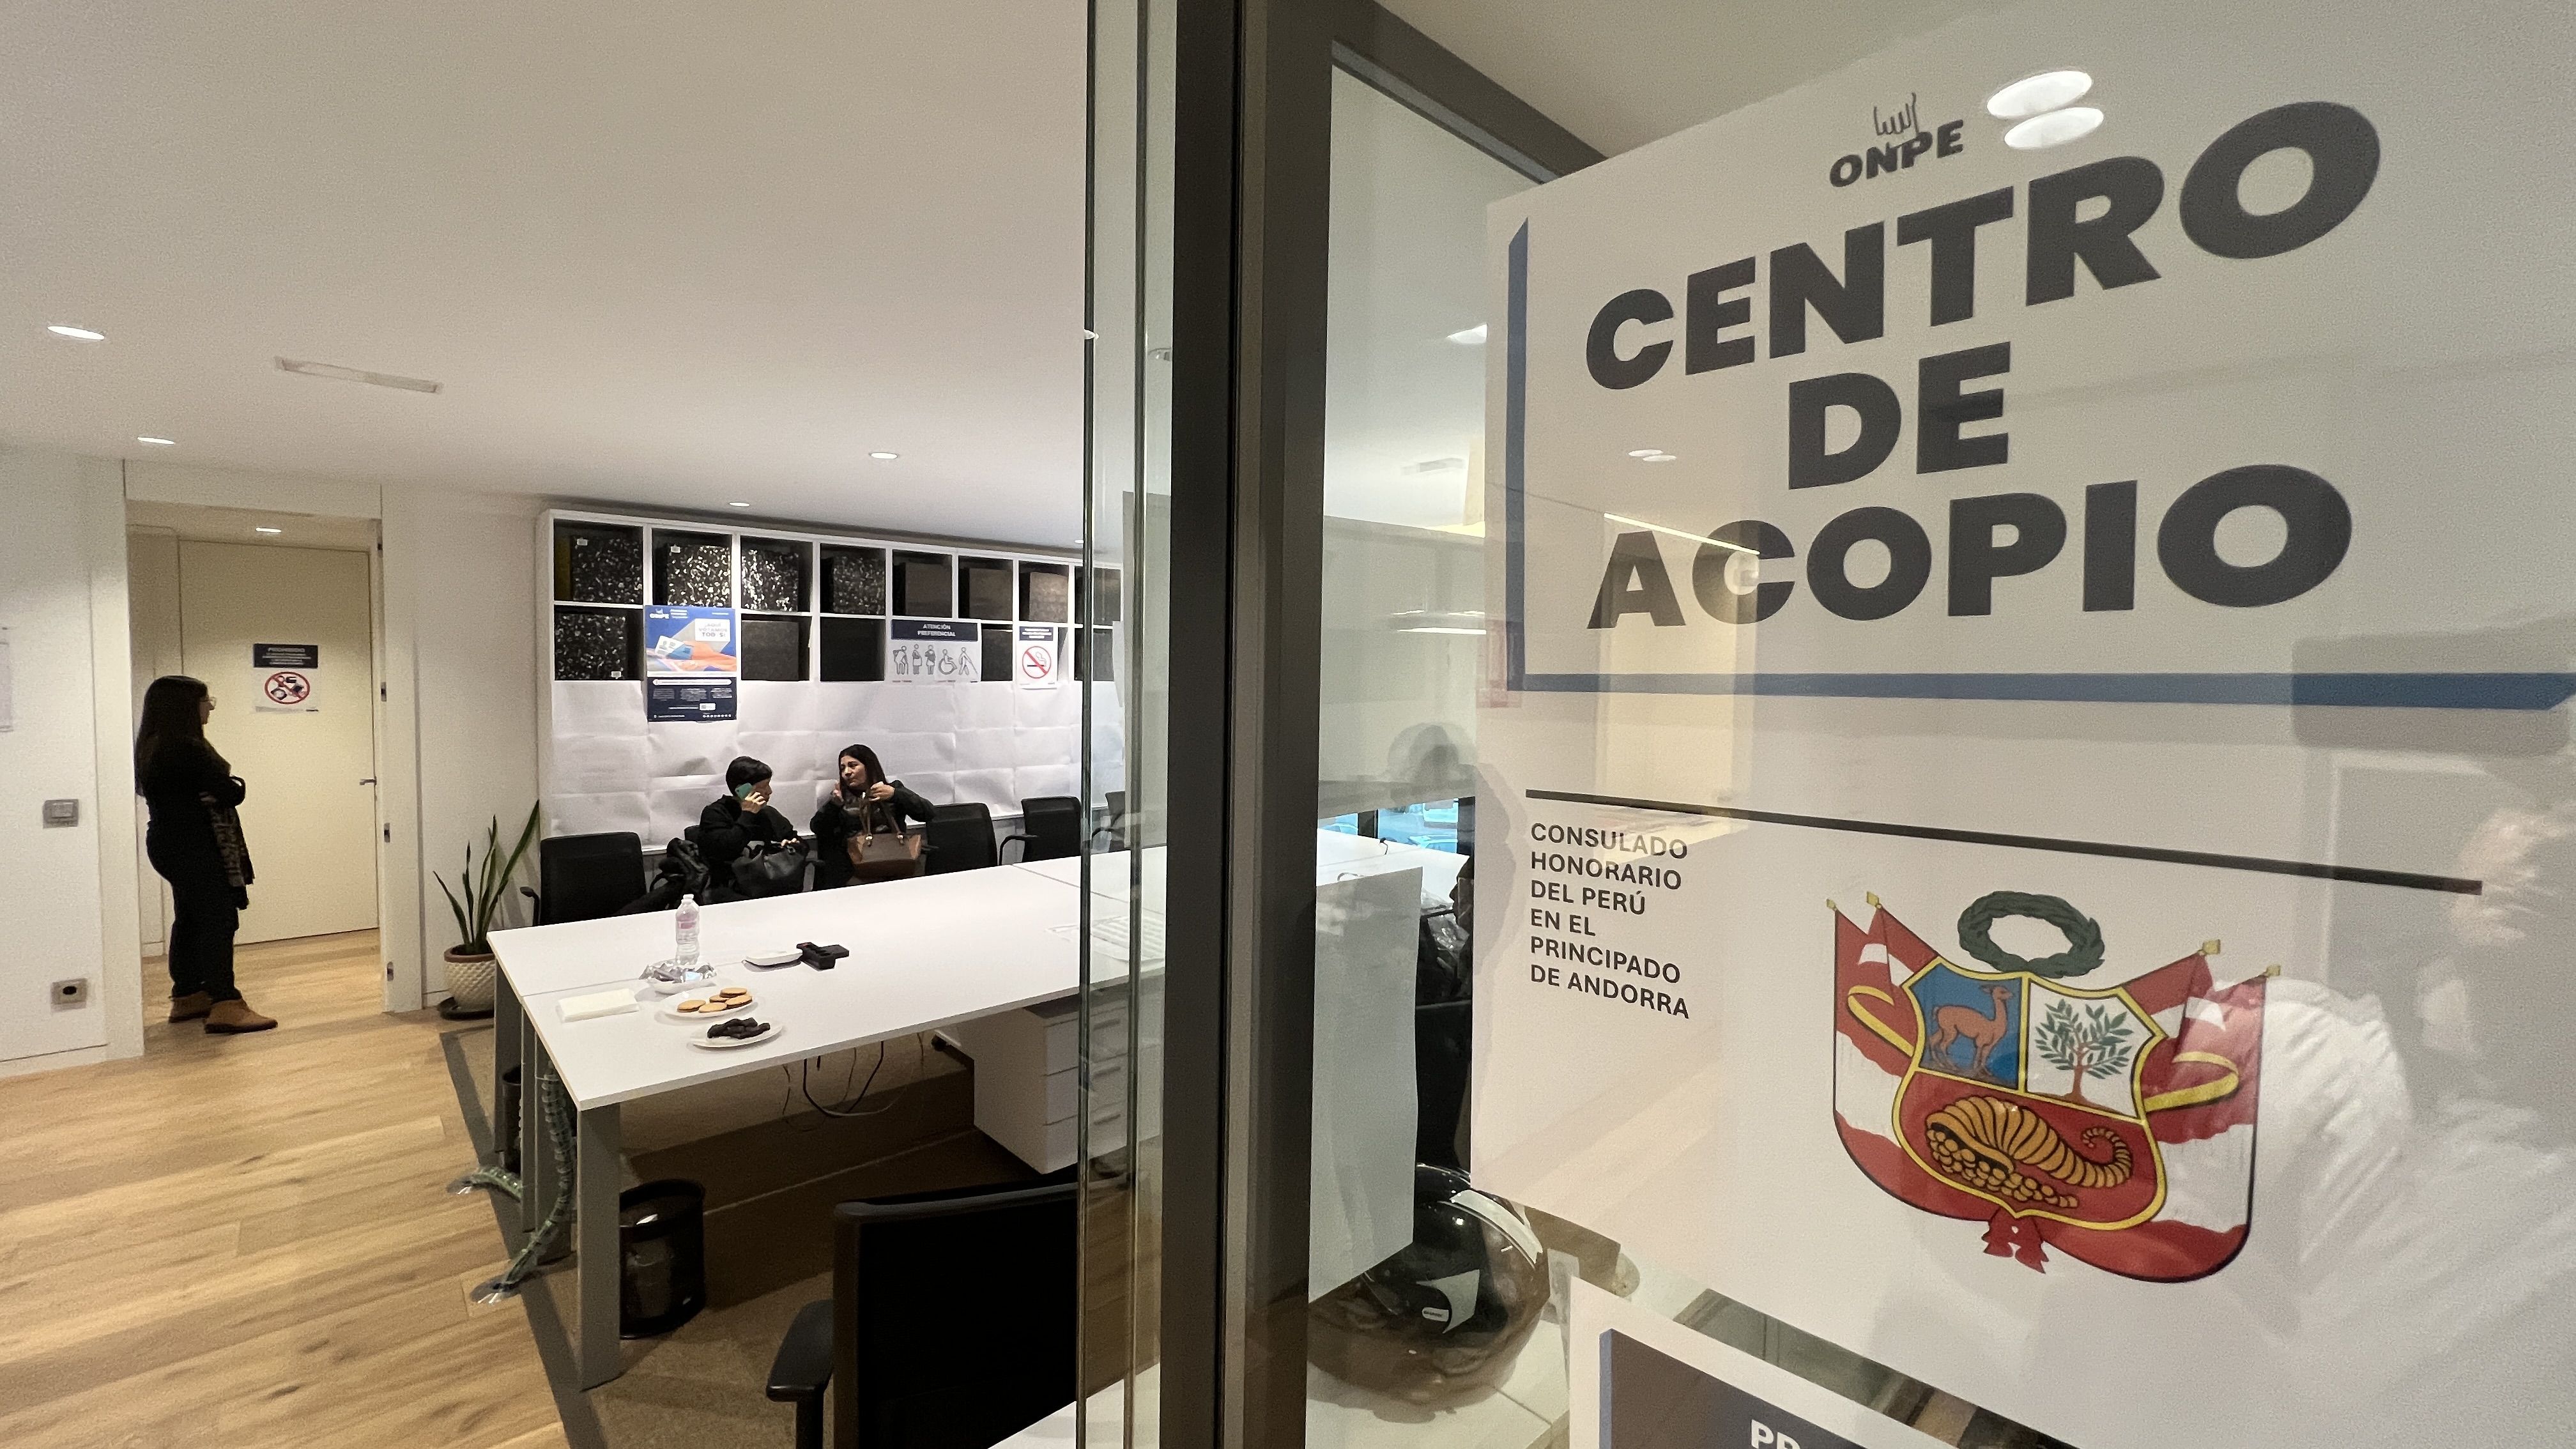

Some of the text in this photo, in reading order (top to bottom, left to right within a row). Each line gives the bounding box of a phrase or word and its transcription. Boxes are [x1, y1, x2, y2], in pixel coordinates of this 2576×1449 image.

[1830, 119, 1964, 187] ONPE
[1586, 102, 2380, 390] CENTRO
[1789, 342, 2011, 489] DE
[1588, 464, 2352, 630] ACOPIO
[1531, 822, 1688, 859] CONSULADO
[1531, 851, 1682, 890] HONORARIO
[1530, 908, 1596, 937] EN EL
[1531, 879, 1646, 916] DEL PERÚ
[1531, 935, 1680, 984] PRINCIPADO
[1531, 963, 1690, 1020] DE ANDORRA
